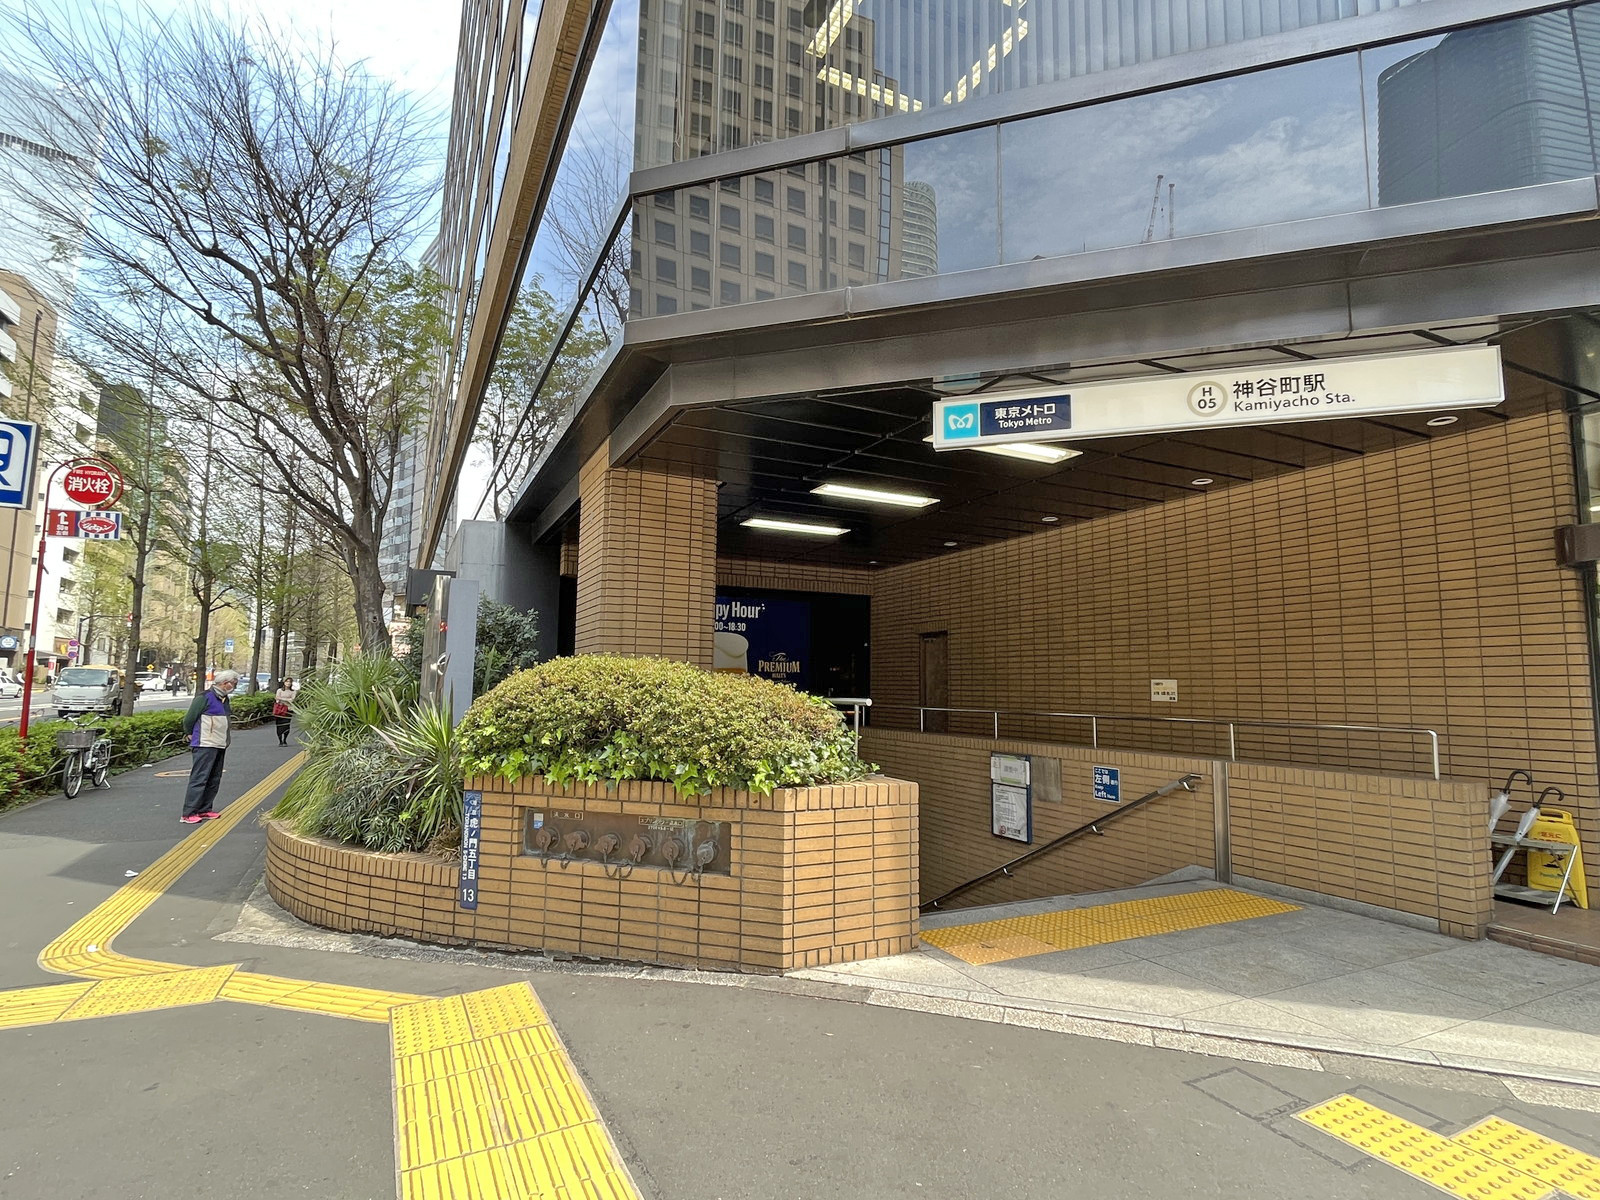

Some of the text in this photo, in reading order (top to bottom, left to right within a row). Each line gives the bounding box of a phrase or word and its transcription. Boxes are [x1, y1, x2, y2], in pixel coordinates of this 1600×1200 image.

[1202, 387, 1212, 397] H
[1232, 373, 1326, 399] 神谷町駅
[1197, 398, 1217, 409] 05
[1234, 392, 1356, 412] Kamiyacho Sta.
[994, 403, 1056, 420] 東京メトロ
[998, 417, 1052, 429] Tokyo Metro
[68, 476, 110, 494] 消火栓
[732, 602, 760, 618] Hour
[758, 660, 800, 673] PREMIUM
[467, 817, 479, 880] 虎ノ門五丁目
[462, 888, 475, 902] 13
